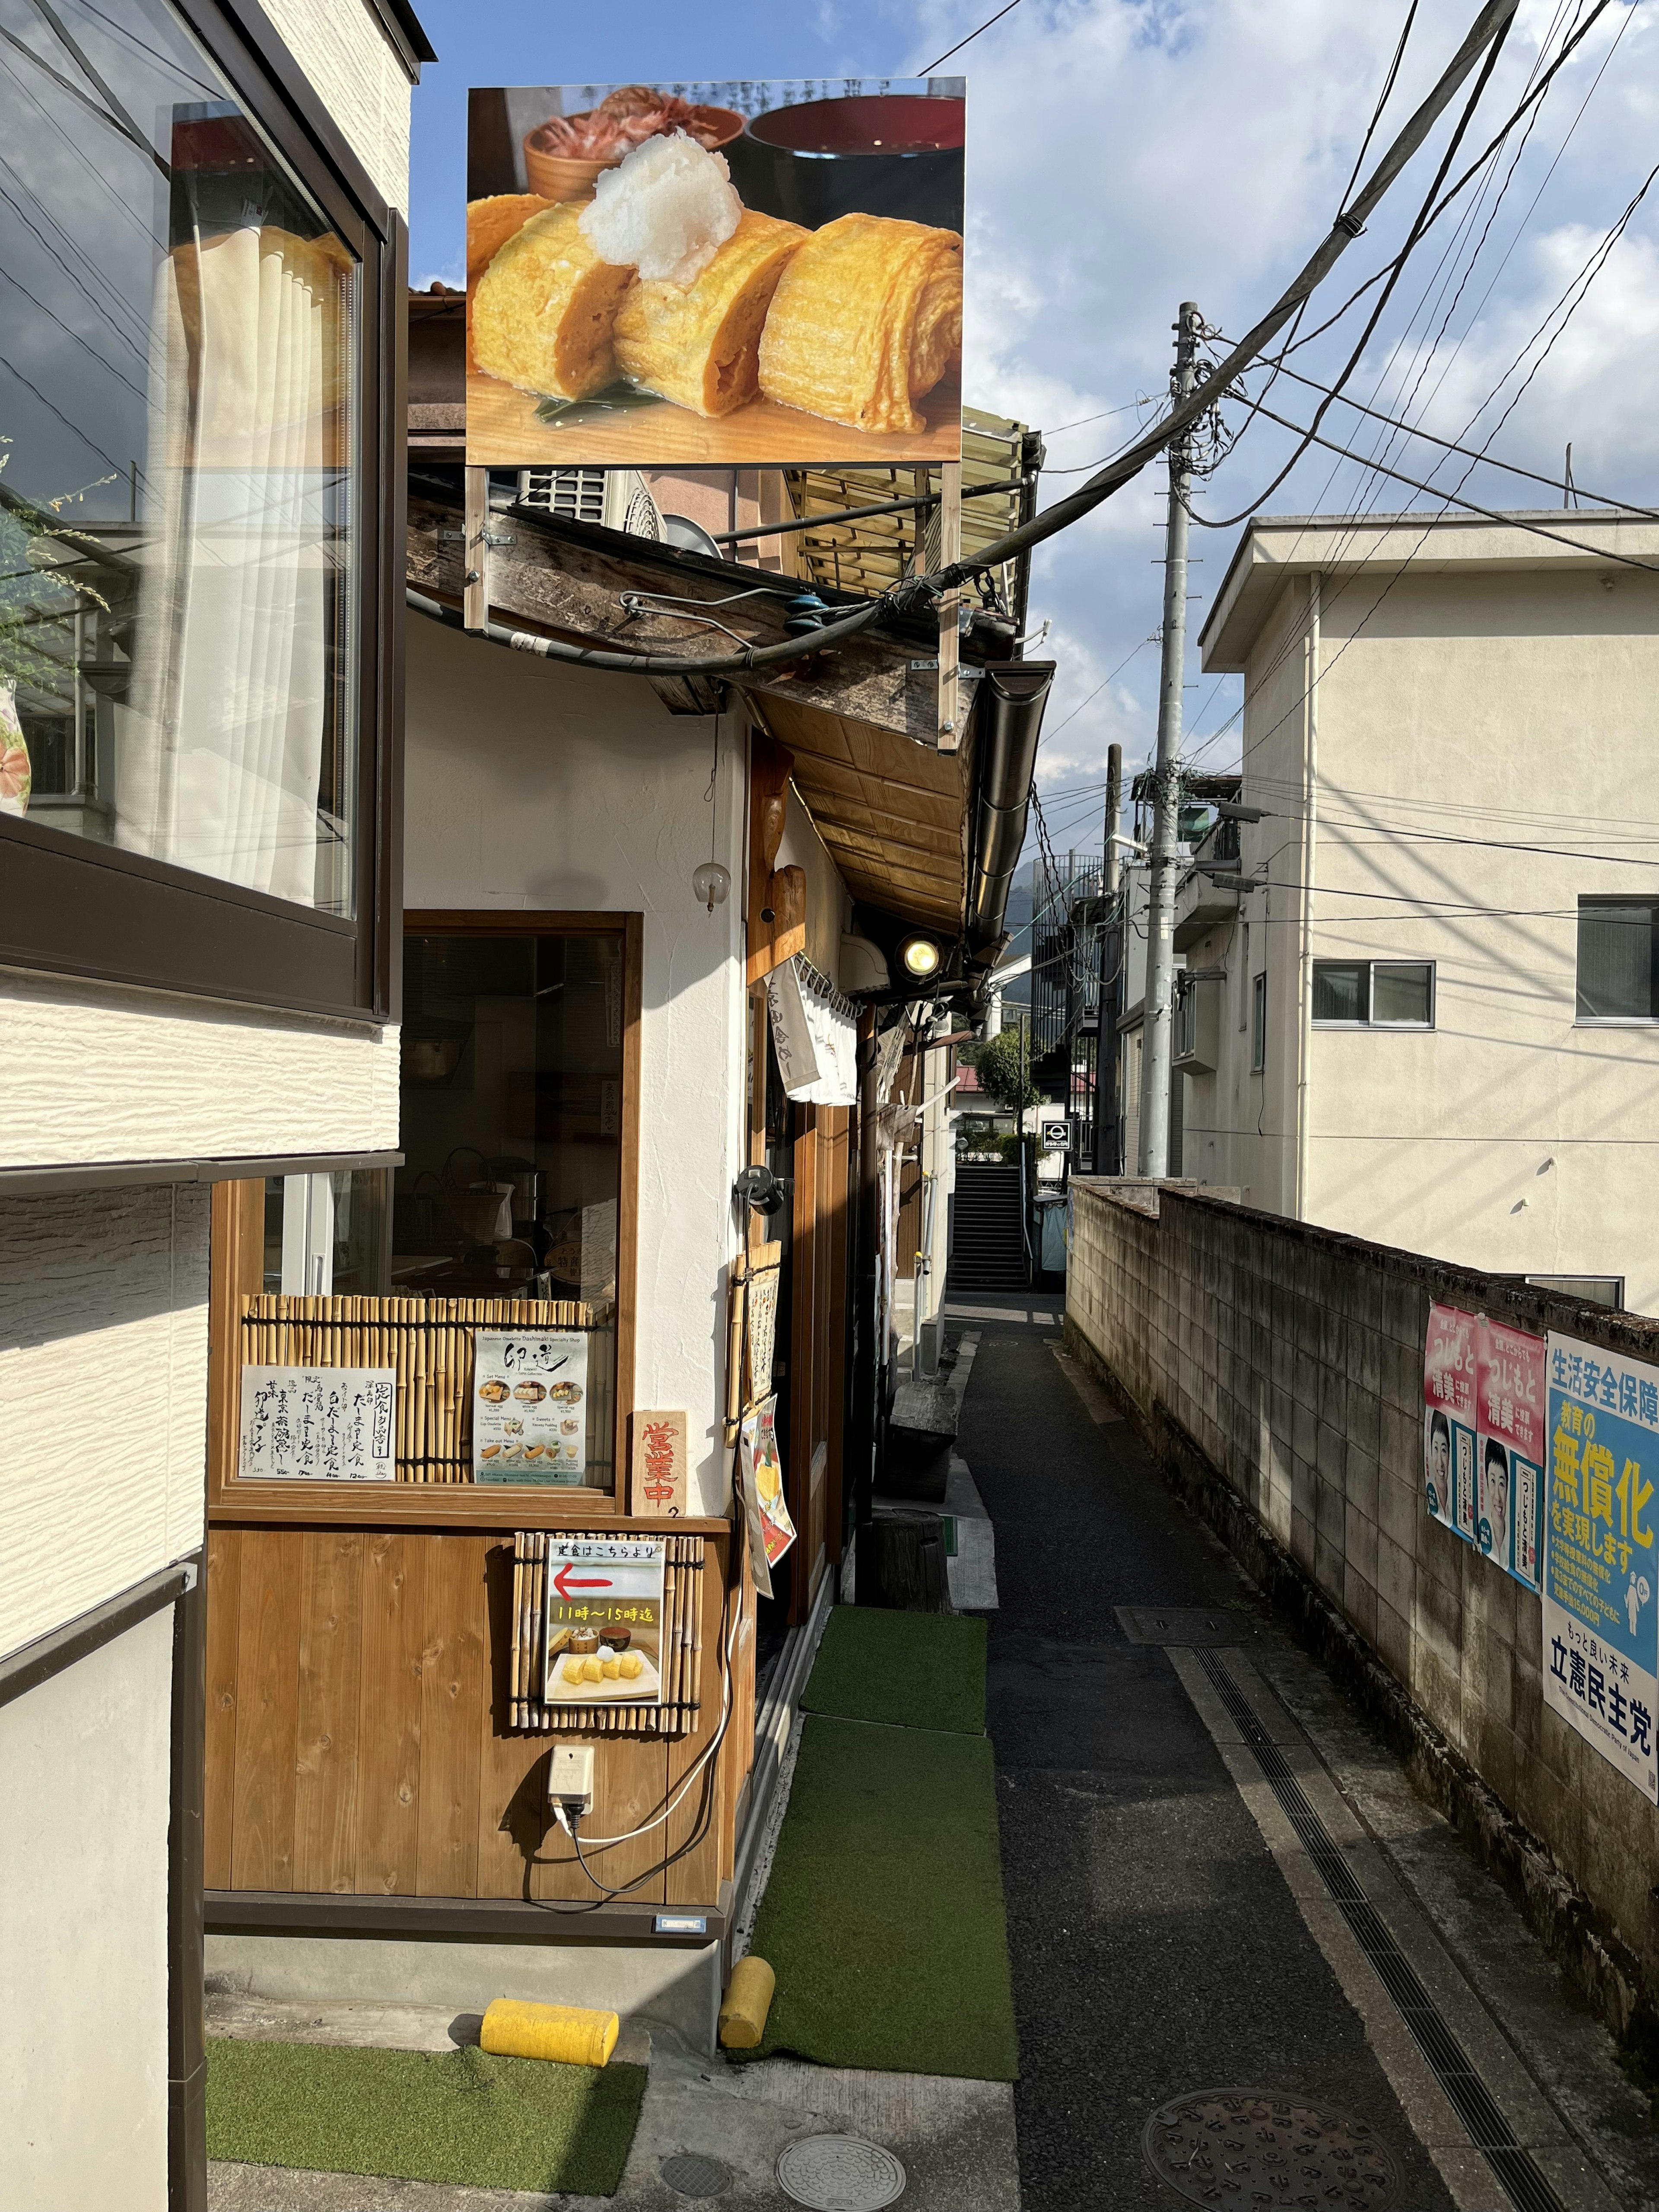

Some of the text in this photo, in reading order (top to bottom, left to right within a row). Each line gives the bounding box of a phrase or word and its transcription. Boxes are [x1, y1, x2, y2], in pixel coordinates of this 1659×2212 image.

[266, 1380, 279, 1398] 甘味
[1432, 1369, 1455, 1404] 清美
[1488, 1391, 1513, 1433] 清美
[1489, 1358, 1536, 1403] つじもと
[1551, 1348, 1659, 1426] 生活安全保障
[252, 1390, 269, 1453] 卵道プリン
[274, 1389, 290, 1465] 東京茶碗蒸し
[296, 1392, 315, 1465] だしまき定食
[324, 1391, 340, 1471] 白だしまき定食
[348, 1393, 366, 1466] だしまき定食
[1515, 1407, 1530, 1424] に投票
[1515, 1424, 1534, 1443] できます
[1561, 1400, 1595, 1440] 教育の
[642, 1421, 679, 1509] 営業中
[1553, 1427, 1654, 1548] 無償化
[558, 1544, 655, 1558] 定食はこちらより
[1551, 1499, 1632, 1575] を実現します
[1567, 1621, 1630, 1684] もっと良い未来
[1550, 1635, 1652, 1757] 立憲民主党
[1589, 1713, 1611, 1739] Democratic
[1611, 1734, 1622, 1749] Party
[1627, 1748, 1640, 1764] Japan
